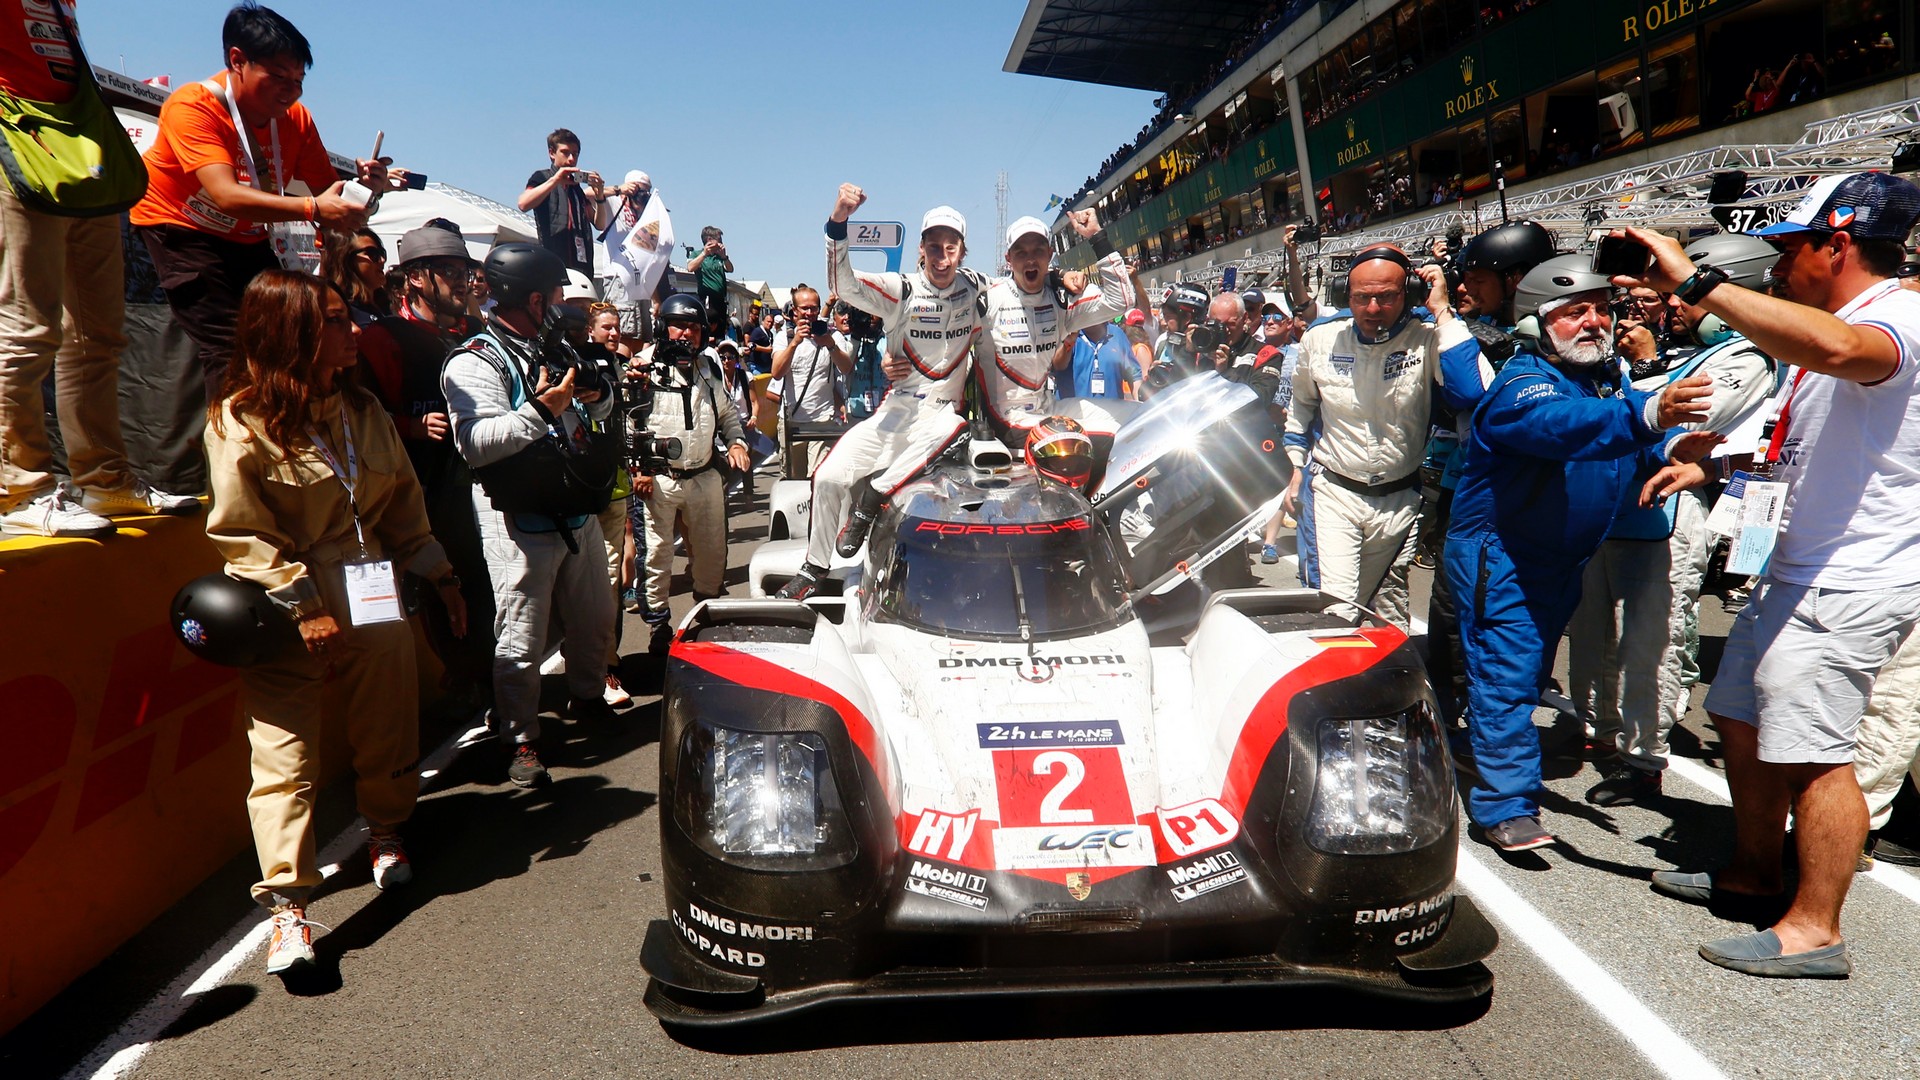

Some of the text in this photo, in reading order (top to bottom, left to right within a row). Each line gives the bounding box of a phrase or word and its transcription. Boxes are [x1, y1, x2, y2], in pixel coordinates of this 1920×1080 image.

[108, 74, 131, 92] Future
[1445, 80, 1499, 119] ROLEX
[1337, 139, 1371, 166] ROLEX
[1254, 157, 1277, 178] ROLEX
[1728, 209, 1756, 234] 37
[858, 225, 881, 239] 24h
[1333, 259, 1348, 270] 63
[913, 305, 935, 313] Mobil
[1000, 317, 1020, 326] Mobil
[910, 329, 942, 340] DMG
[1002, 344, 1032, 355] DMG
[1384, 357, 1422, 375] LE MANS
[916, 518, 1090, 535] PORSCHE
[1248, 519, 1267, 533] Hartley
[1221, 536, 1241, 551] Bamber
[1191, 555, 1214, 572] Bernhard
[938, 655, 1126, 668] DMG MORI
[988, 726, 1114, 741] 24h LE MANS
[1033, 751, 1094, 823] 2
[908, 812, 979, 861] HY
[1165, 809, 1228, 847] P1
[1038, 830, 1134, 851] WEC
[910, 861, 967, 888] Mobil
[1167, 856, 1222, 885] Mobil
[1195, 868, 1244, 891] MICHELIN
[929, 886, 986, 906] MICHELIN
[689, 903, 813, 941] DMG MORI
[1354, 901, 1416, 924] DMG
[672, 908, 766, 968] CHOPARD
